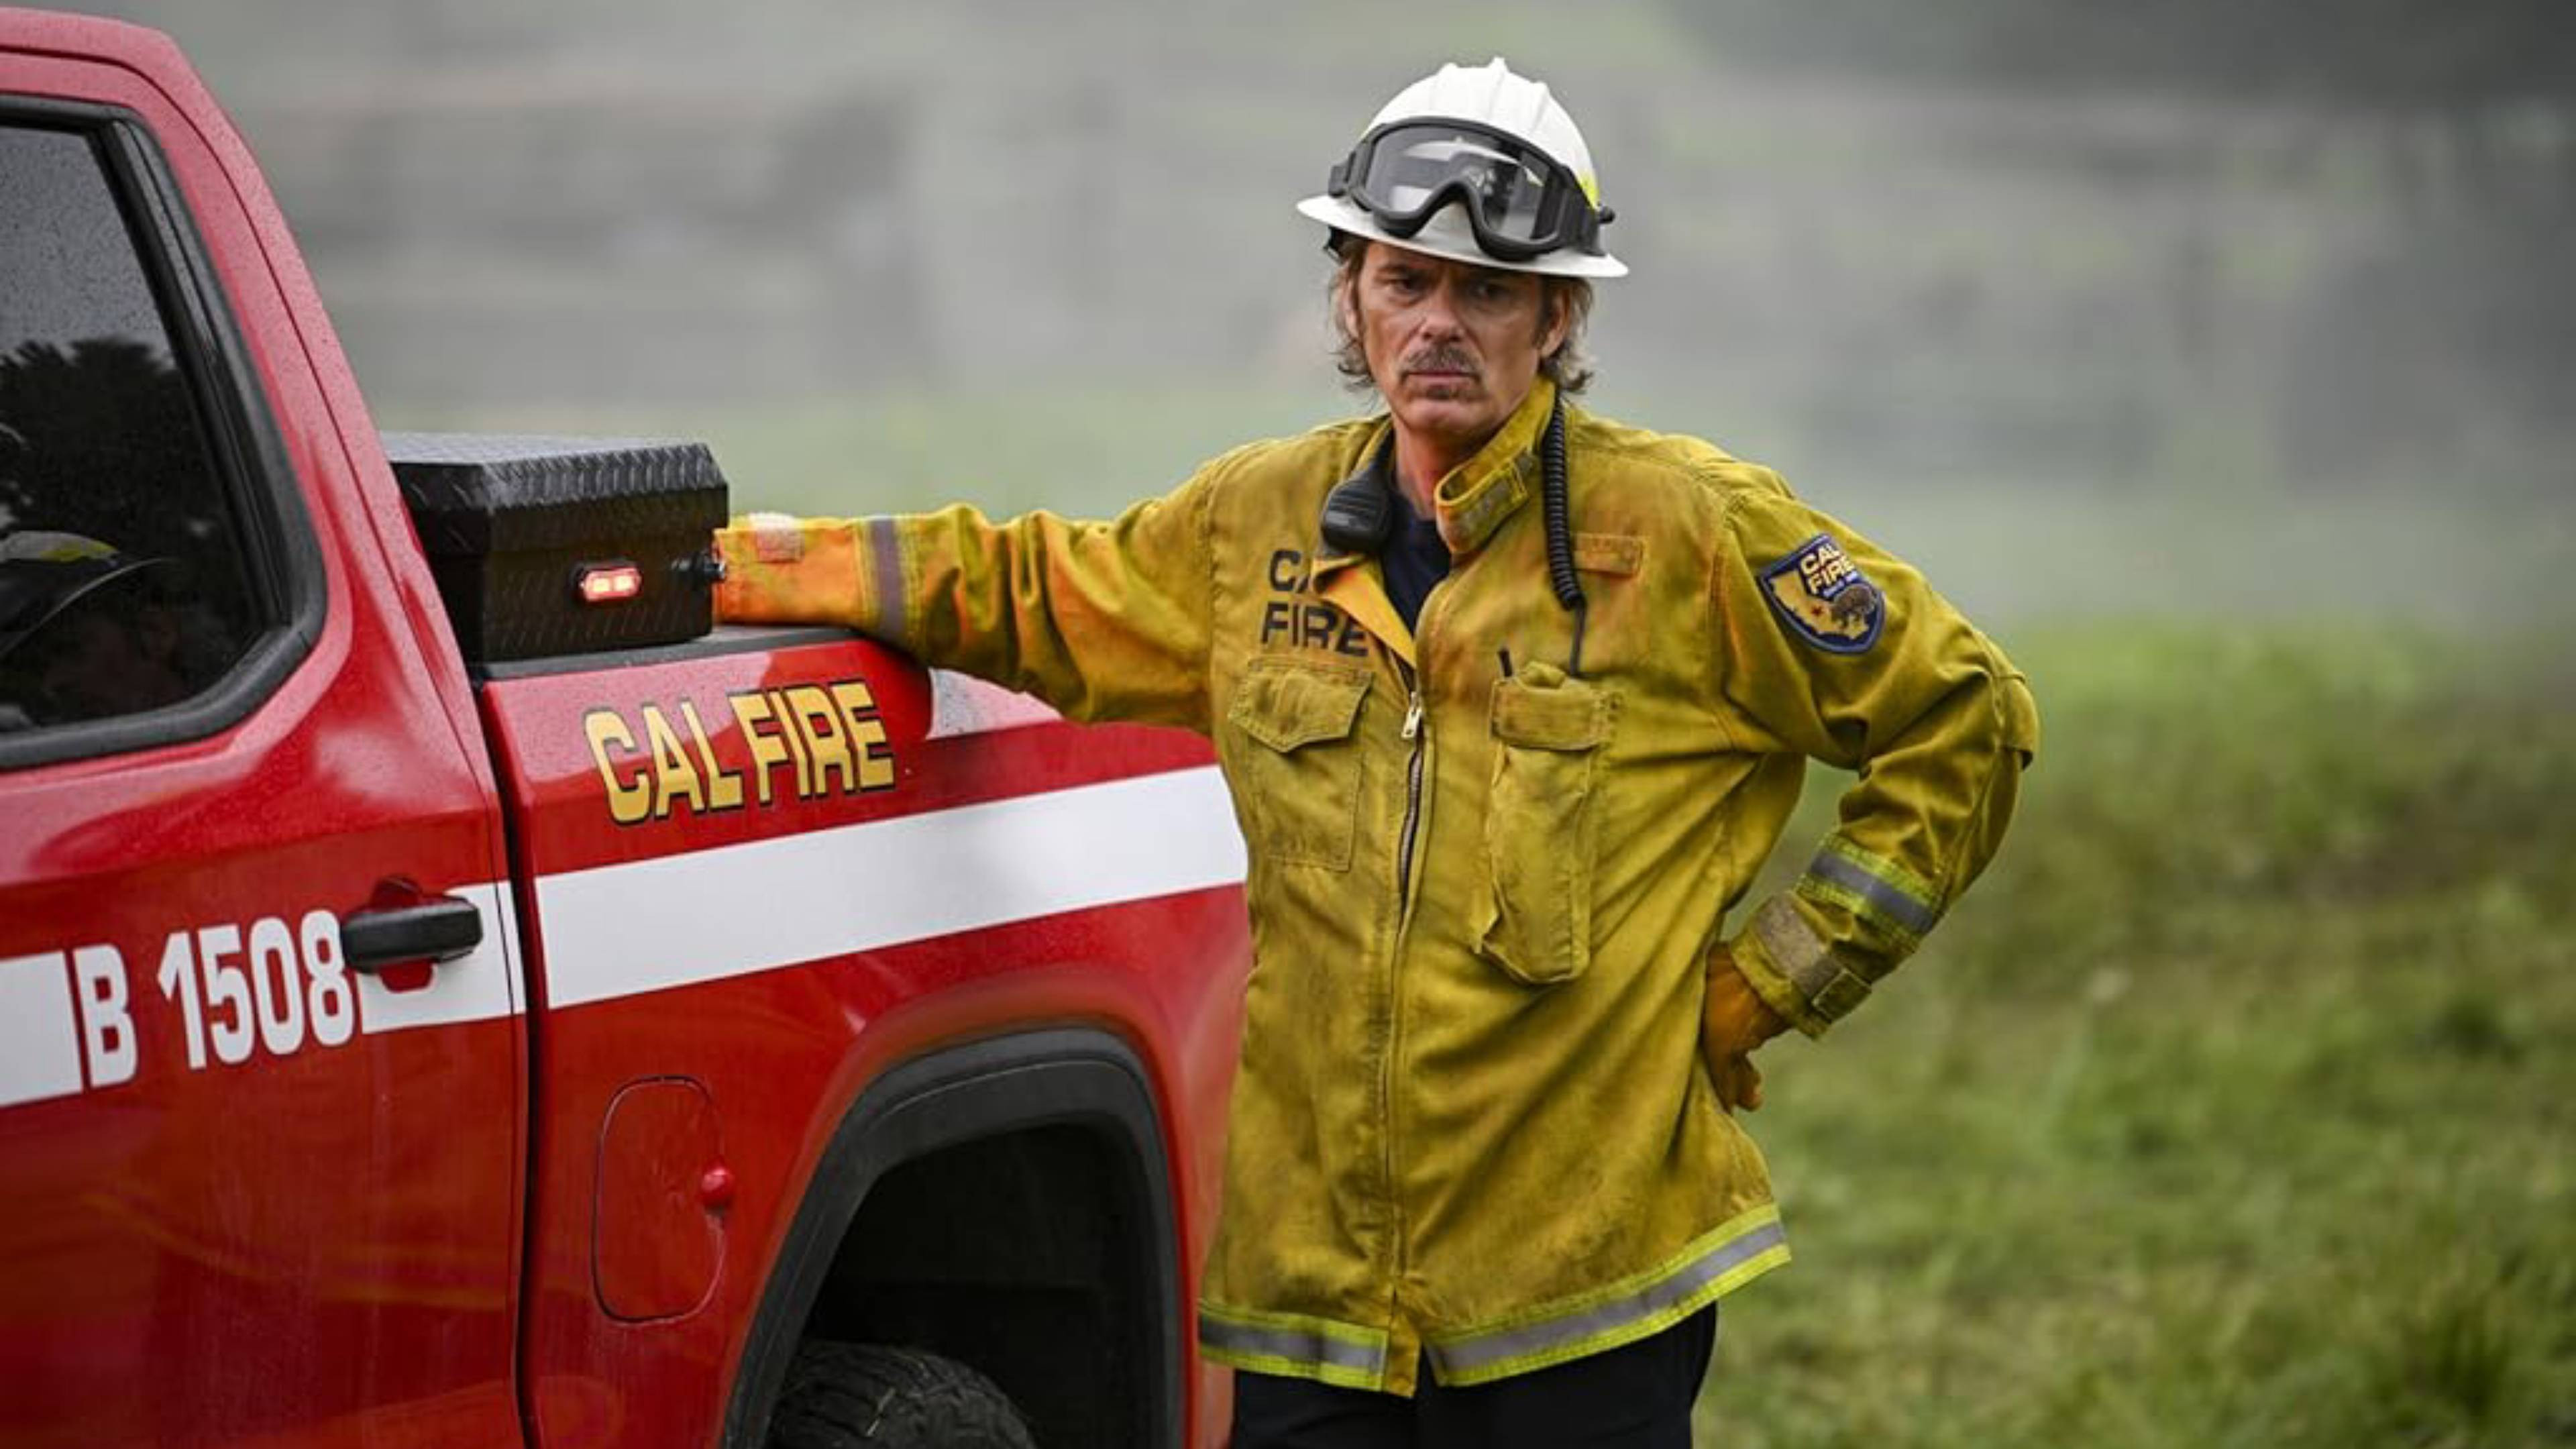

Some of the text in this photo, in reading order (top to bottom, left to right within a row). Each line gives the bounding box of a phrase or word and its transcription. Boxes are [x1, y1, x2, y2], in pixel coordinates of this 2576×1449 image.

[1801, 543, 1840, 576] CAL
[1808, 555, 1855, 595] FIRE
[1261, 601, 1368, 657] FIRE
[584, 678, 895, 825] CAL FIRE
[72, 909, 354, 1089] B 1508
